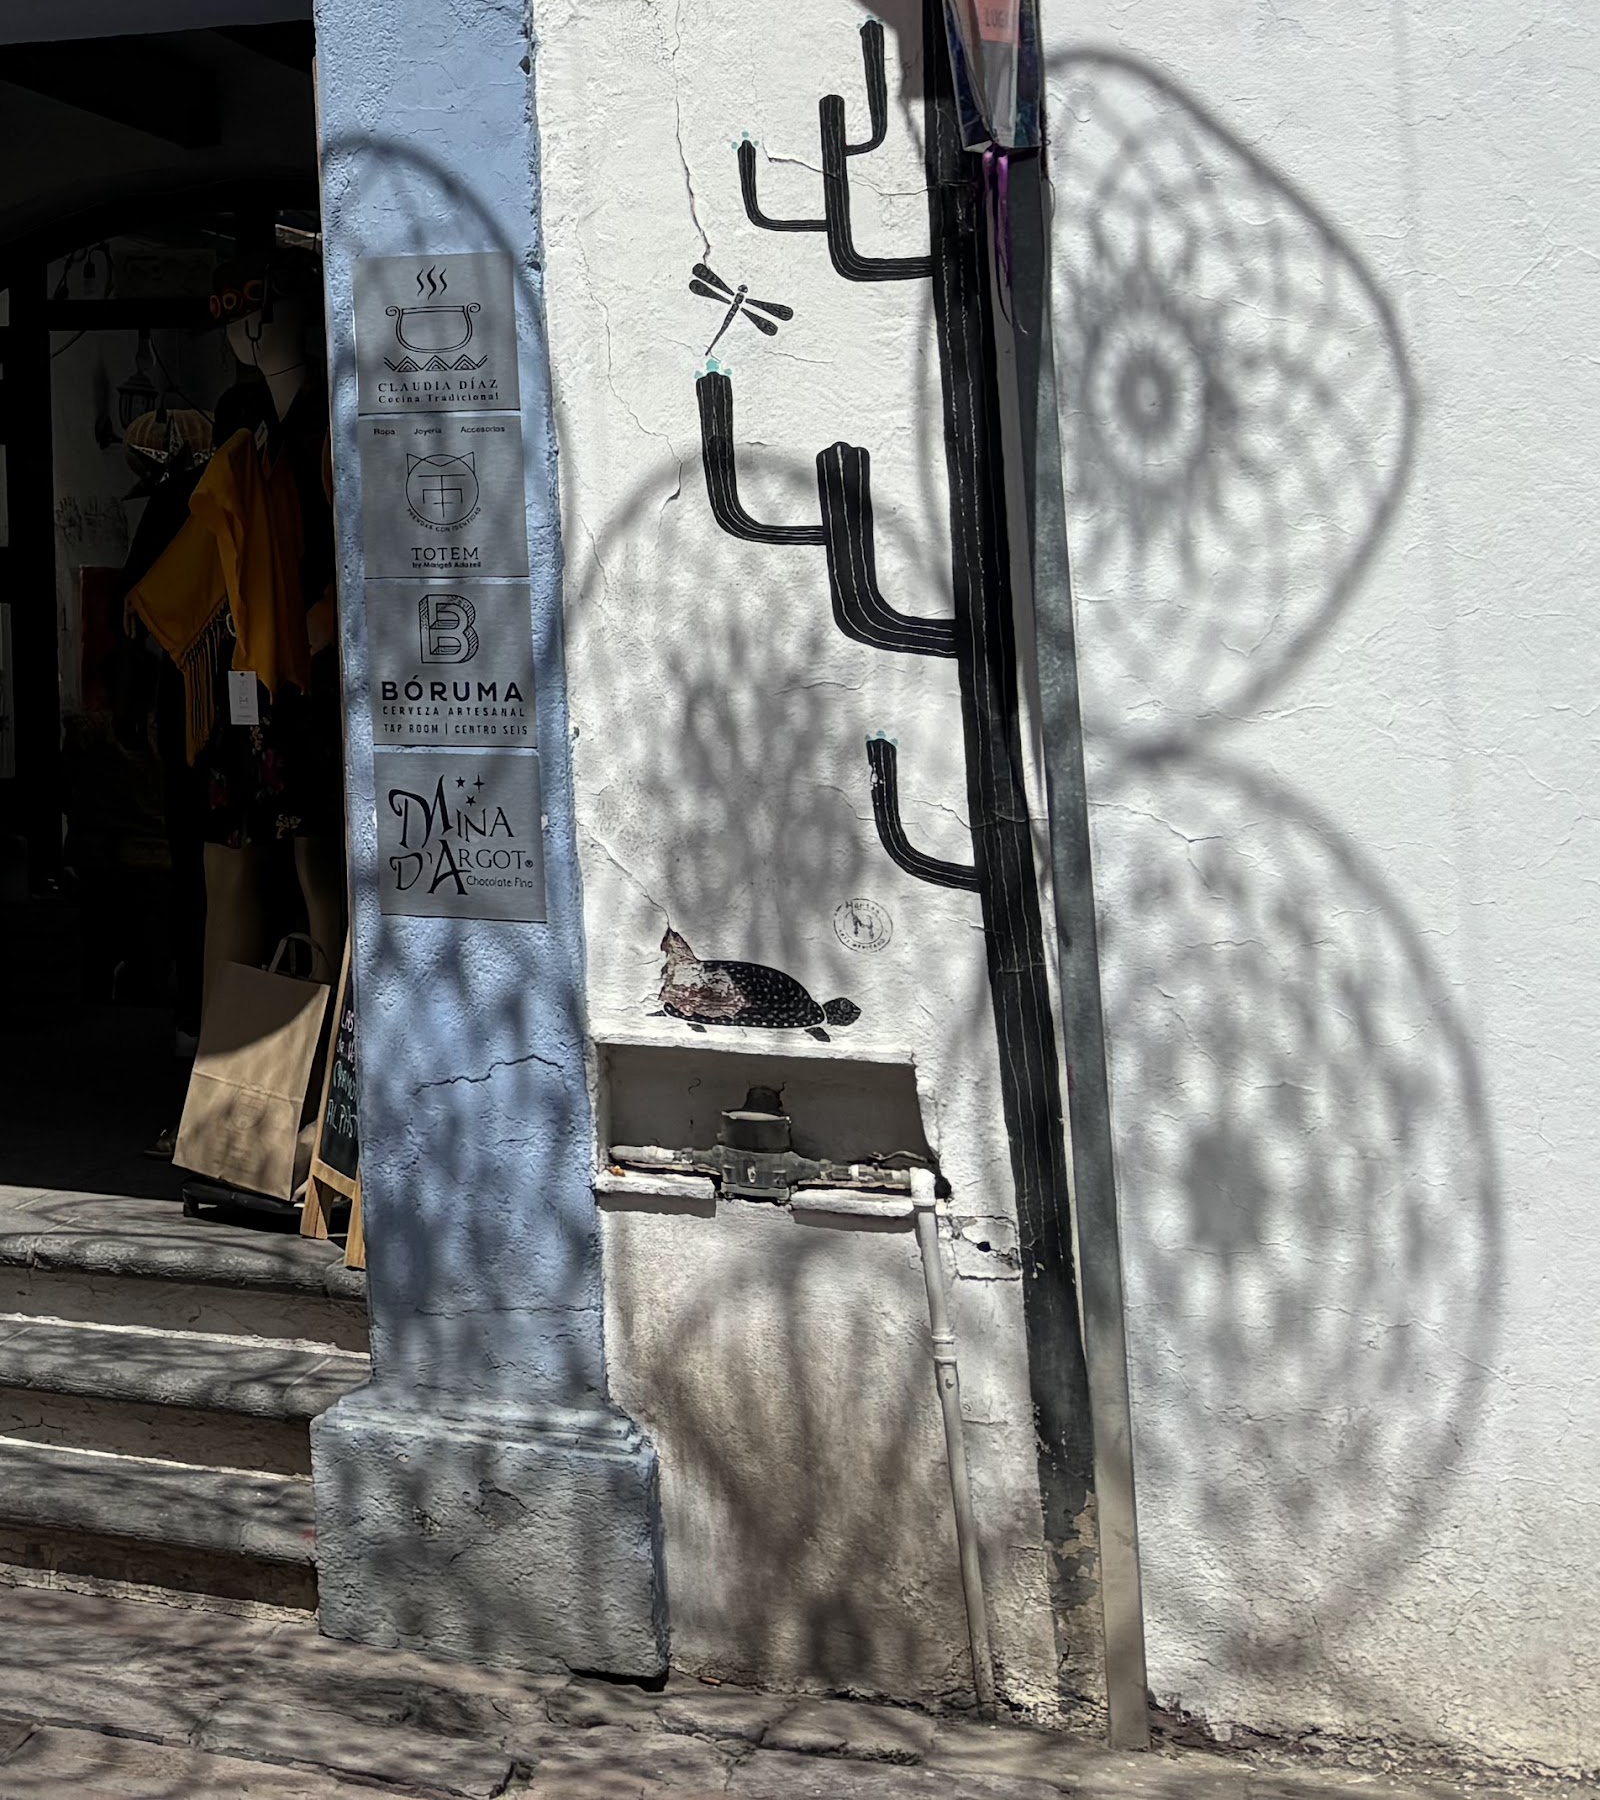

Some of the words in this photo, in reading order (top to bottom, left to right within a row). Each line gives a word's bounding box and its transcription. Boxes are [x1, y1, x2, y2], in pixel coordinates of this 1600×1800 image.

[378, 380, 451, 392] CLAUDIA
[459, 377, 498, 390] DÍAZ
[378, 395, 420, 404] Cocina
[427, 392, 499, 402] Tradicional
[373, 428, 396, 436] Ropa
[411, 547, 479, 561] TOTEM
[382, 675, 524, 702] BÓRUMA
[383, 706, 439, 716] CERVEZA
[448, 707, 525, 717] ARTESANAL
[384, 723, 402, 733] TAP
[409, 724, 439, 734] ROOM
[454, 725, 497, 734] CENTRO
[503, 725, 528, 735] SEIS
[466, 875, 512, 887] Chocolate
[515, 876, 534, 888] Fino
